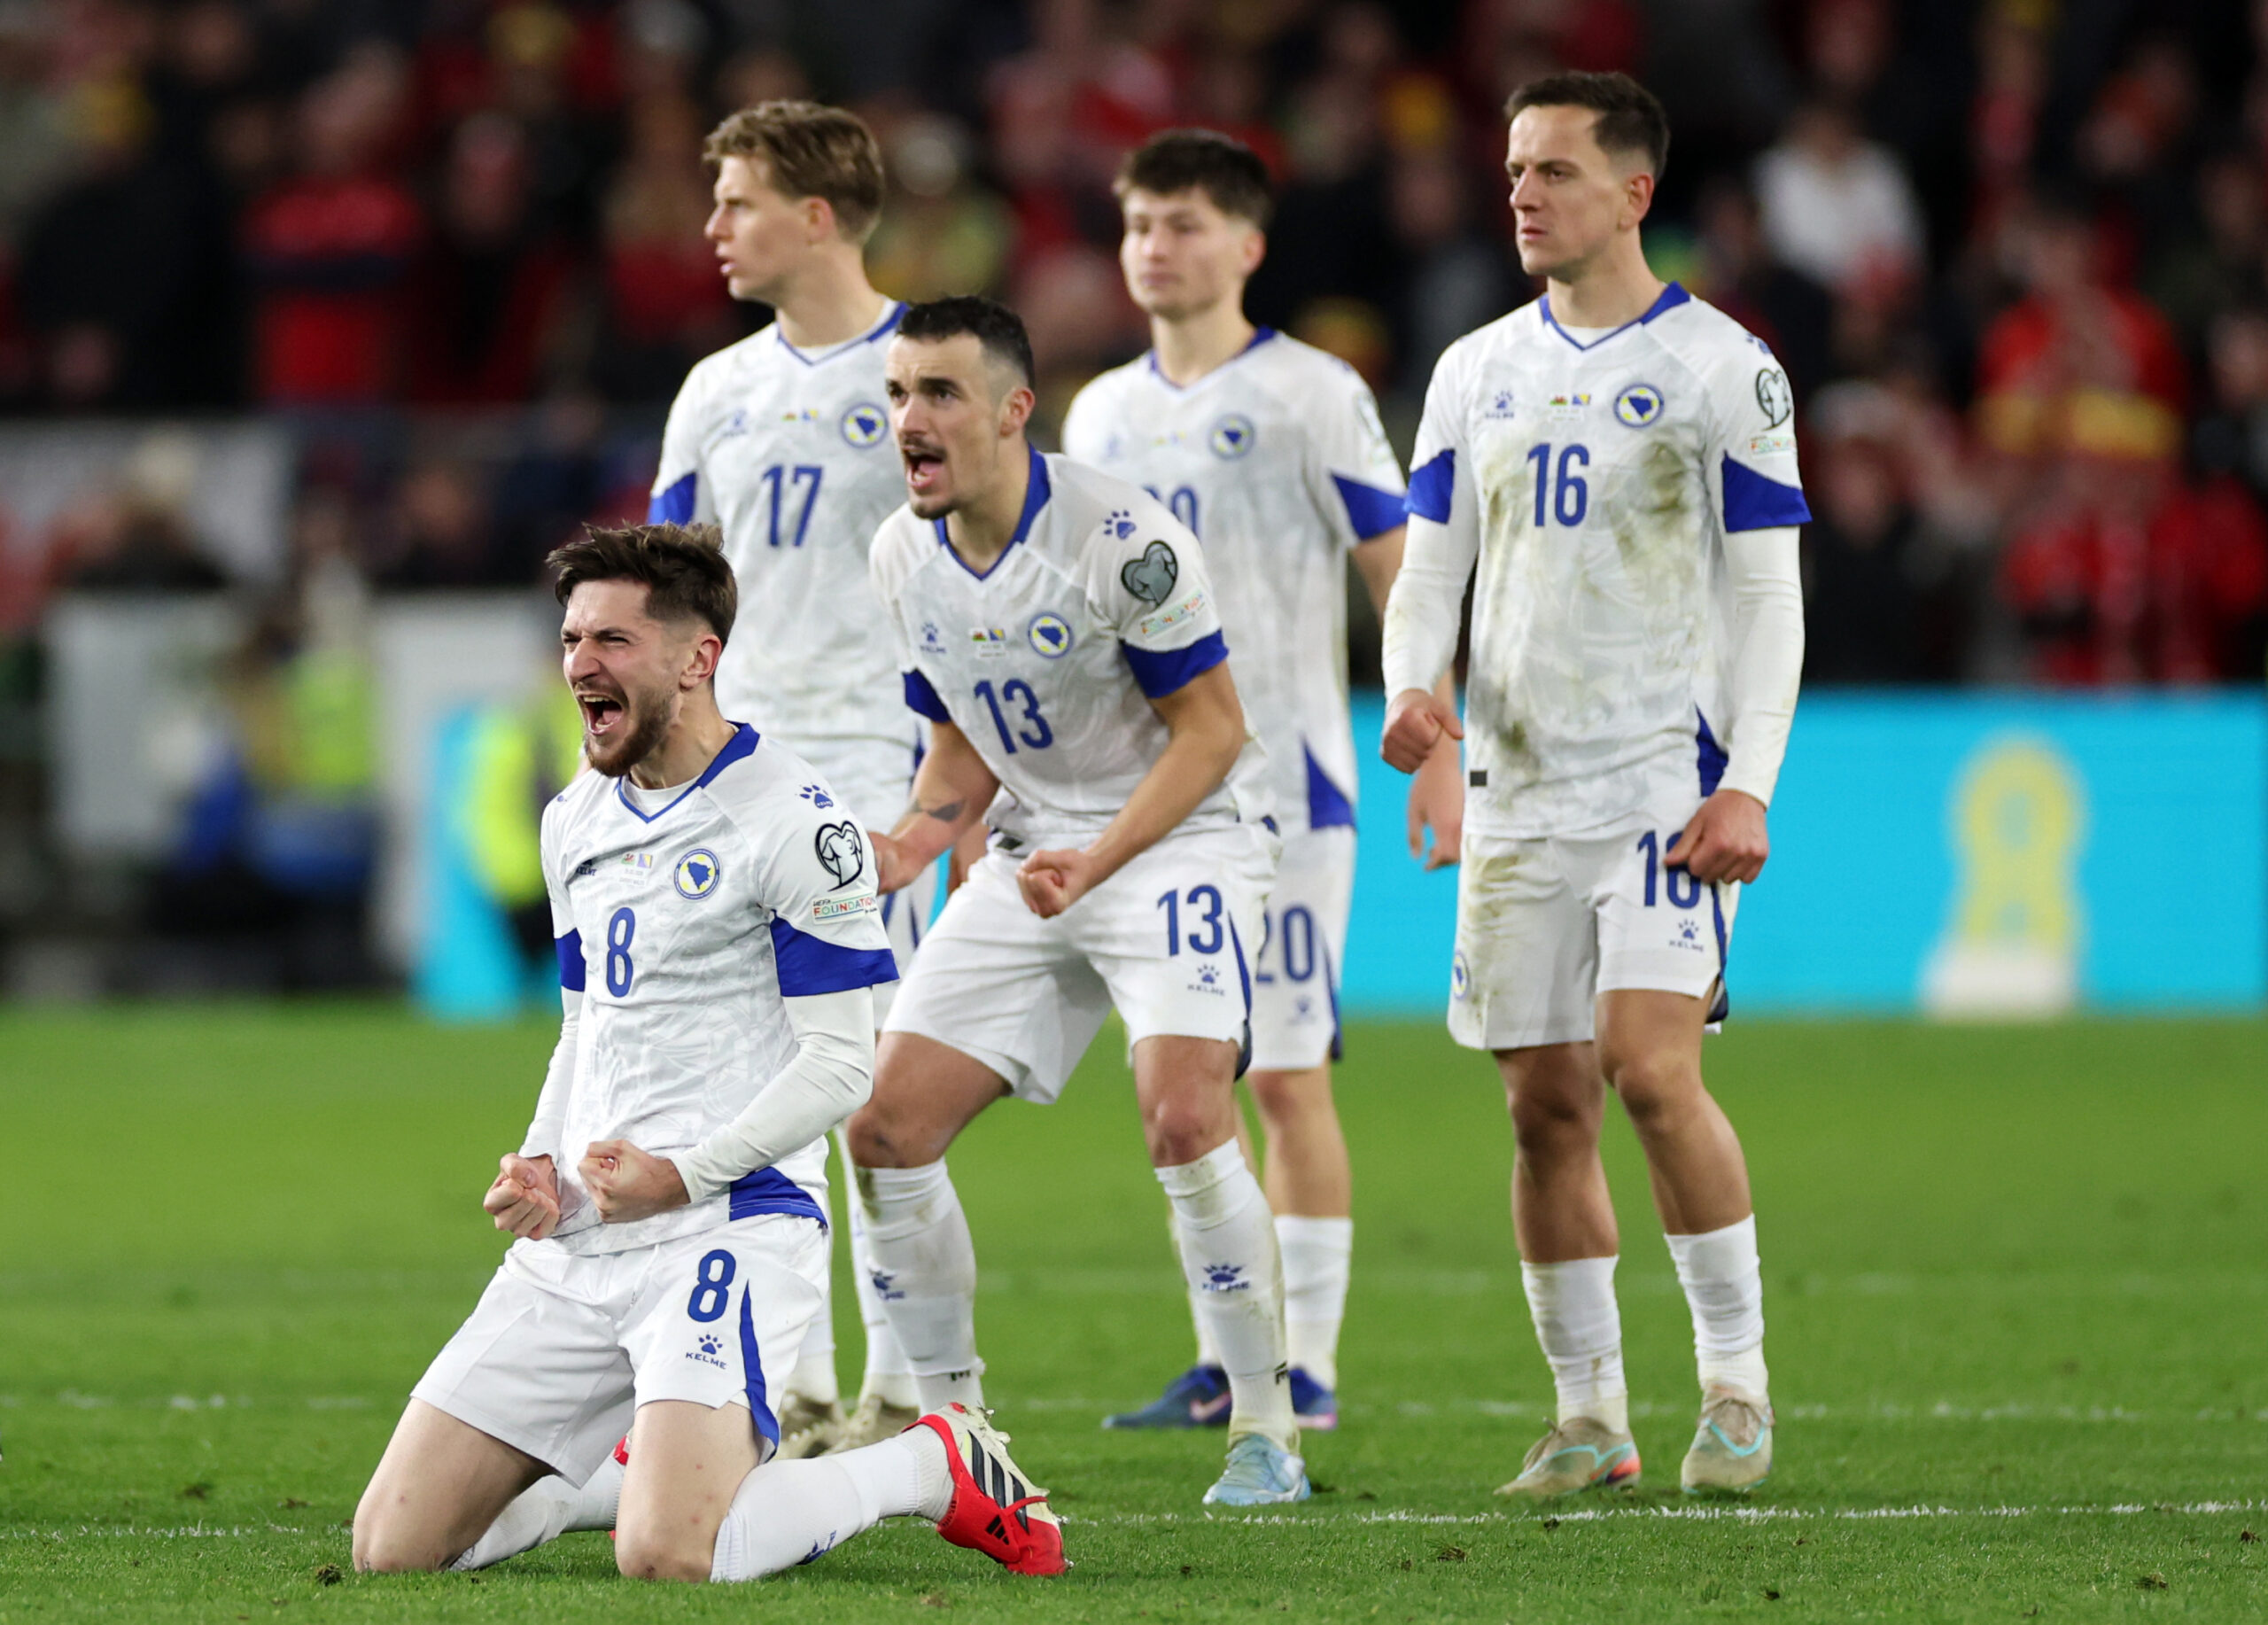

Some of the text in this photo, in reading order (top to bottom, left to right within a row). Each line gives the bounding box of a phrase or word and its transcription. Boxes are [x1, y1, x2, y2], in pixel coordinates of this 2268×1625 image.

[761, 463, 823, 548] 17
[1527, 443, 1589, 527] 16
[975, 678, 1053, 755] 13
[1637, 829, 1701, 909] 16
[606, 906, 636, 998] 8
[1157, 883, 1223, 957] 13
[687, 1248, 737, 1323] 8
[685, 1351, 727, 1370] KELME
